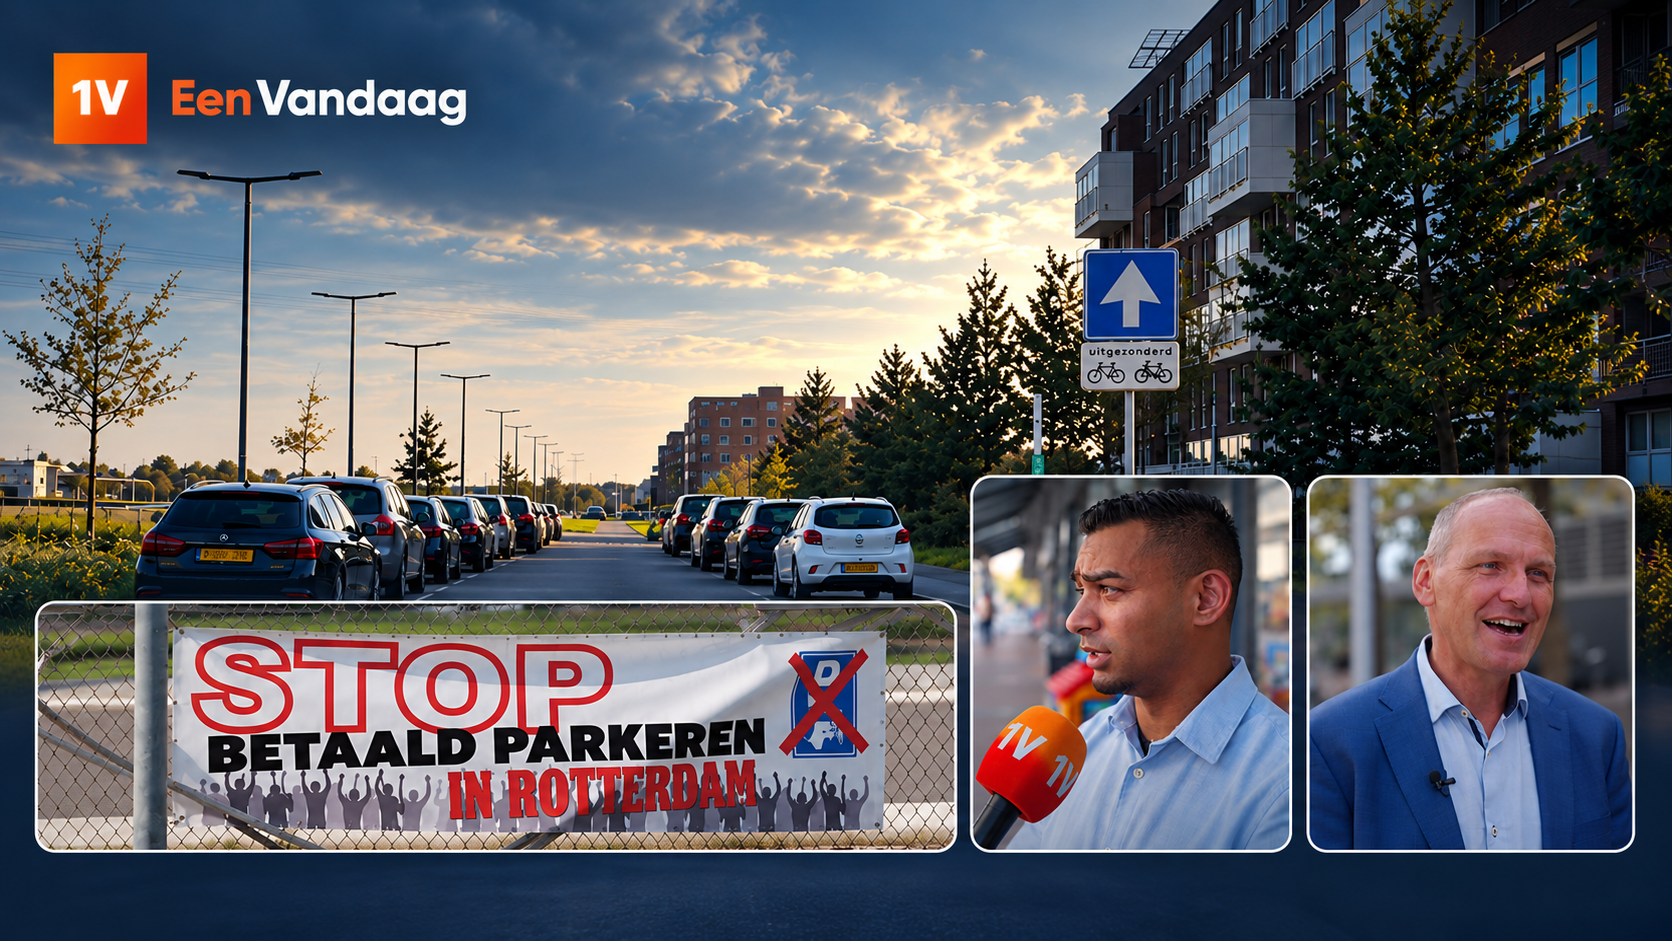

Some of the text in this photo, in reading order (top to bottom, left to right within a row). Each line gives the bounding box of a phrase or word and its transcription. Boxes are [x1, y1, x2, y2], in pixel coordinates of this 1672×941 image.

[1089, 347, 1173, 359] uitgezonderd
[191, 636, 614, 736] STOP
[208, 717, 766, 773] BETAALD PARKEREN
[997, 722, 1048, 761] 1V
[447, 759, 757, 819] IN ROTTERDAM
